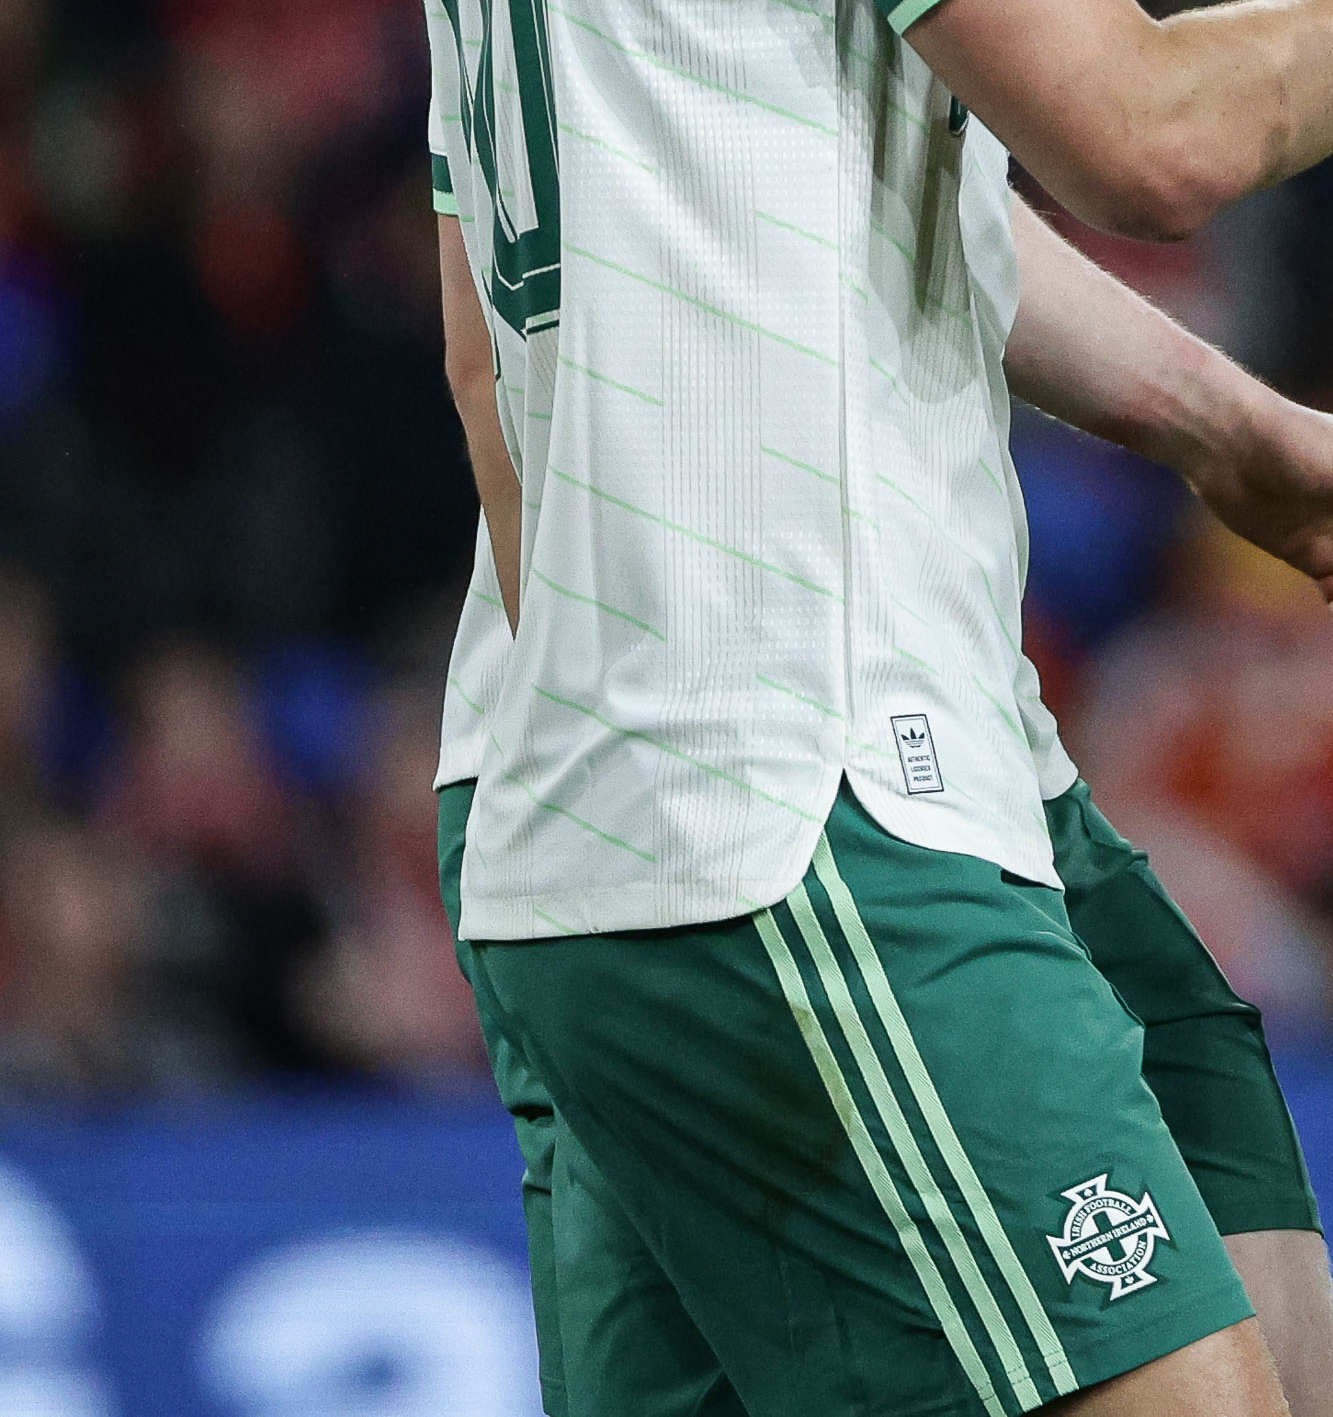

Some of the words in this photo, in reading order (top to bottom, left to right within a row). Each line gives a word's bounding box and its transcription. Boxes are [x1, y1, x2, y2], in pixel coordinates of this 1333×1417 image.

[1070, 1232, 1114, 1257] NORTHERN
[1112, 1217, 1148, 1239] IRELAND
[1071, 1208, 1088, 1238] IRISH
[1086, 1198, 1132, 1216] FOOTBALL
[1089, 1240, 1148, 1275] ASSOCIATION
